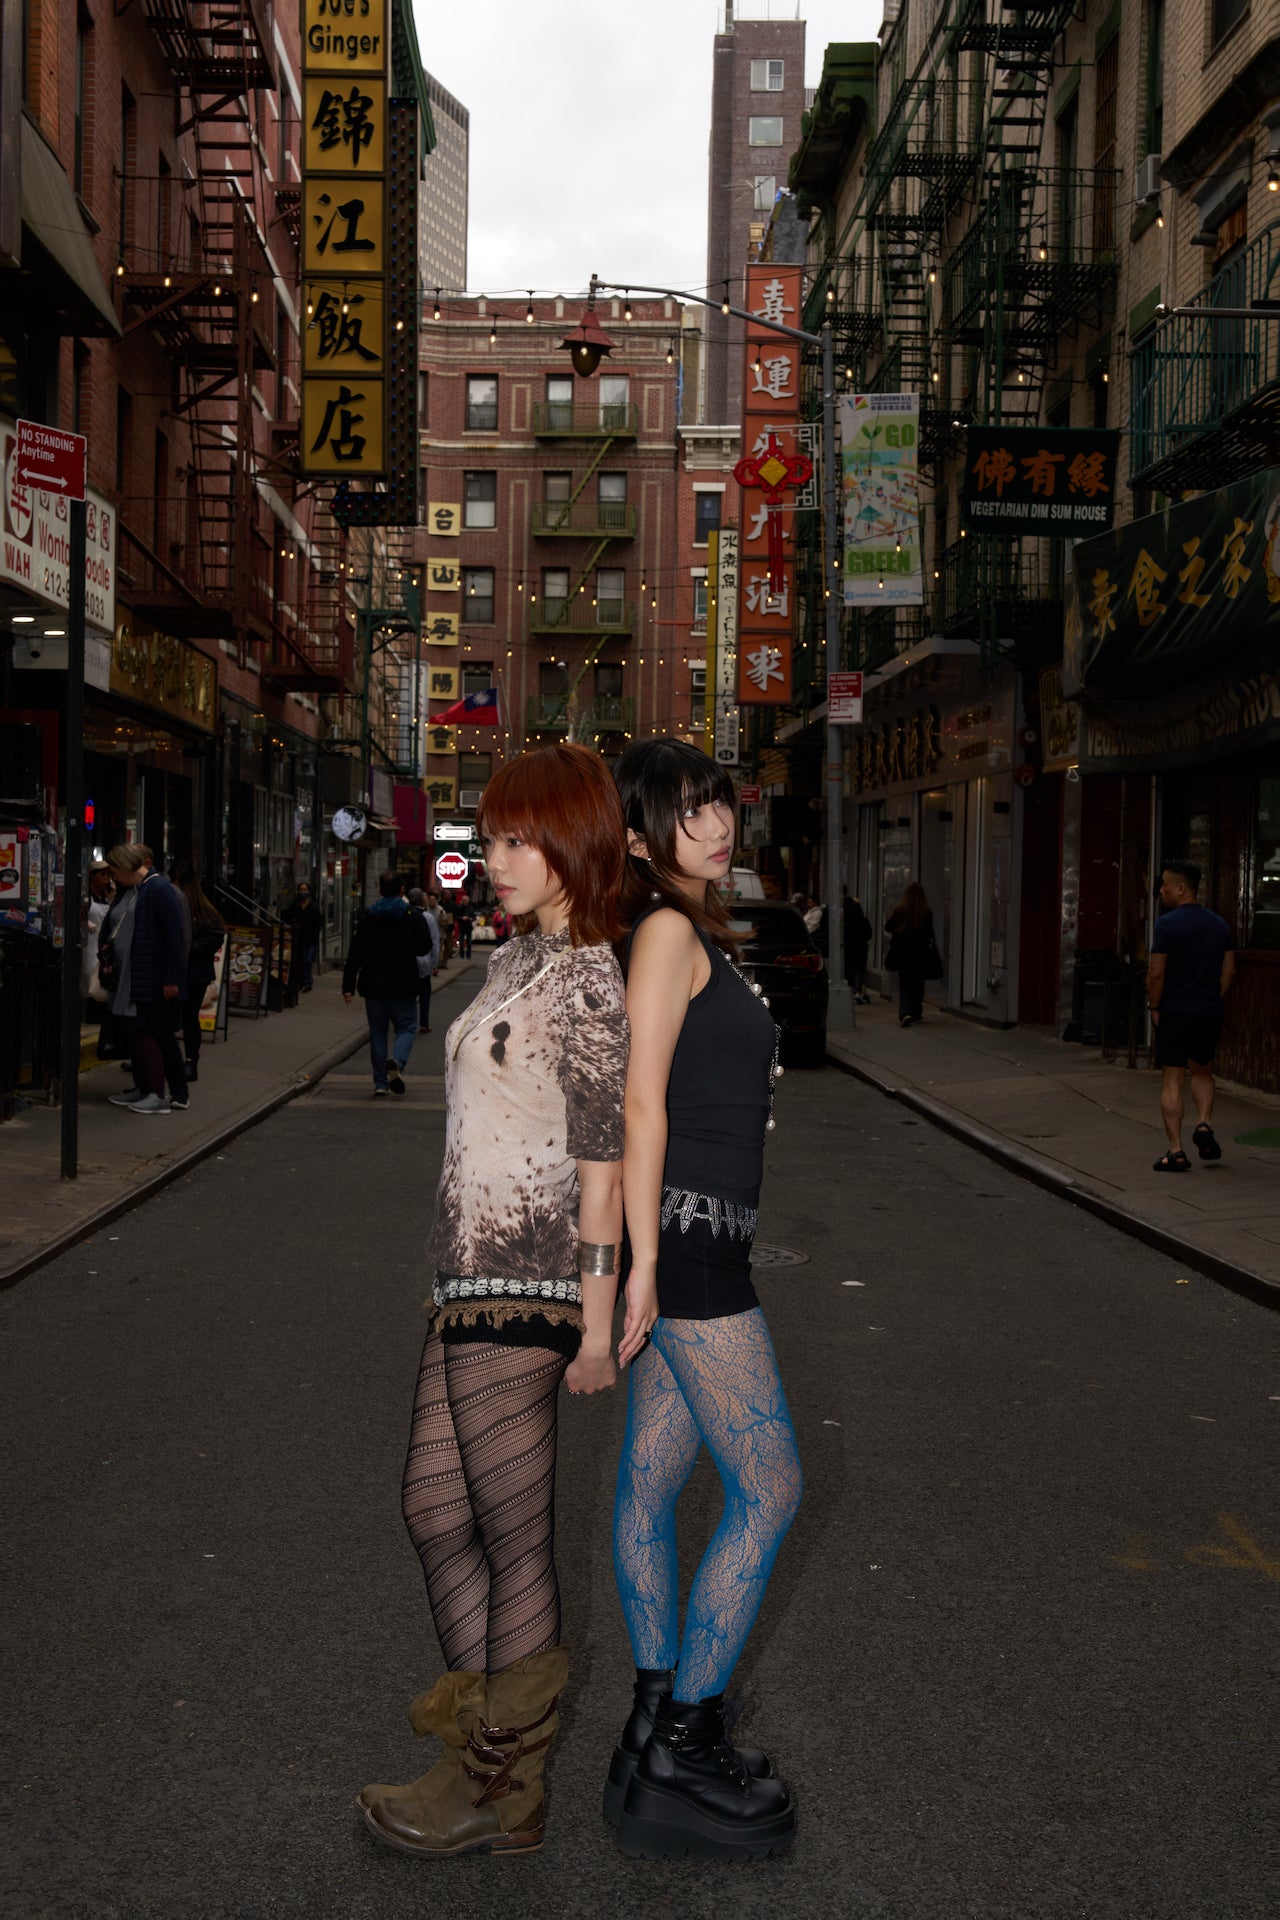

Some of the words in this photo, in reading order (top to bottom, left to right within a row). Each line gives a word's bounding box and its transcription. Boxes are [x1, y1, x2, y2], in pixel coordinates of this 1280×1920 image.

[319, 0, 369, 16] Joes
[308, 24, 380, 60] Ginger
[311, 85, 381, 463] 錦江飯店
[20, 427, 33, 442] NO
[35, 431, 75, 453] STANDING
[885, 424, 915, 447] GO
[21, 445, 55, 463] Anytime
[971, 447, 1110, 498] 佛有緣
[970, 501, 1029, 518] VEGETARIAN
[1030, 503, 1049, 518] DIM
[1051, 504, 1072, 520] SUM
[1074, 506, 1107, 521] HOUSE
[4, 541, 31, 580] WAH
[722, 535, 738, 590] 水煮魚
[848, 551, 911, 574] GREEN
[1088, 516, 1255, 641] 素食之家
[439, 862, 465, 875] STOP
